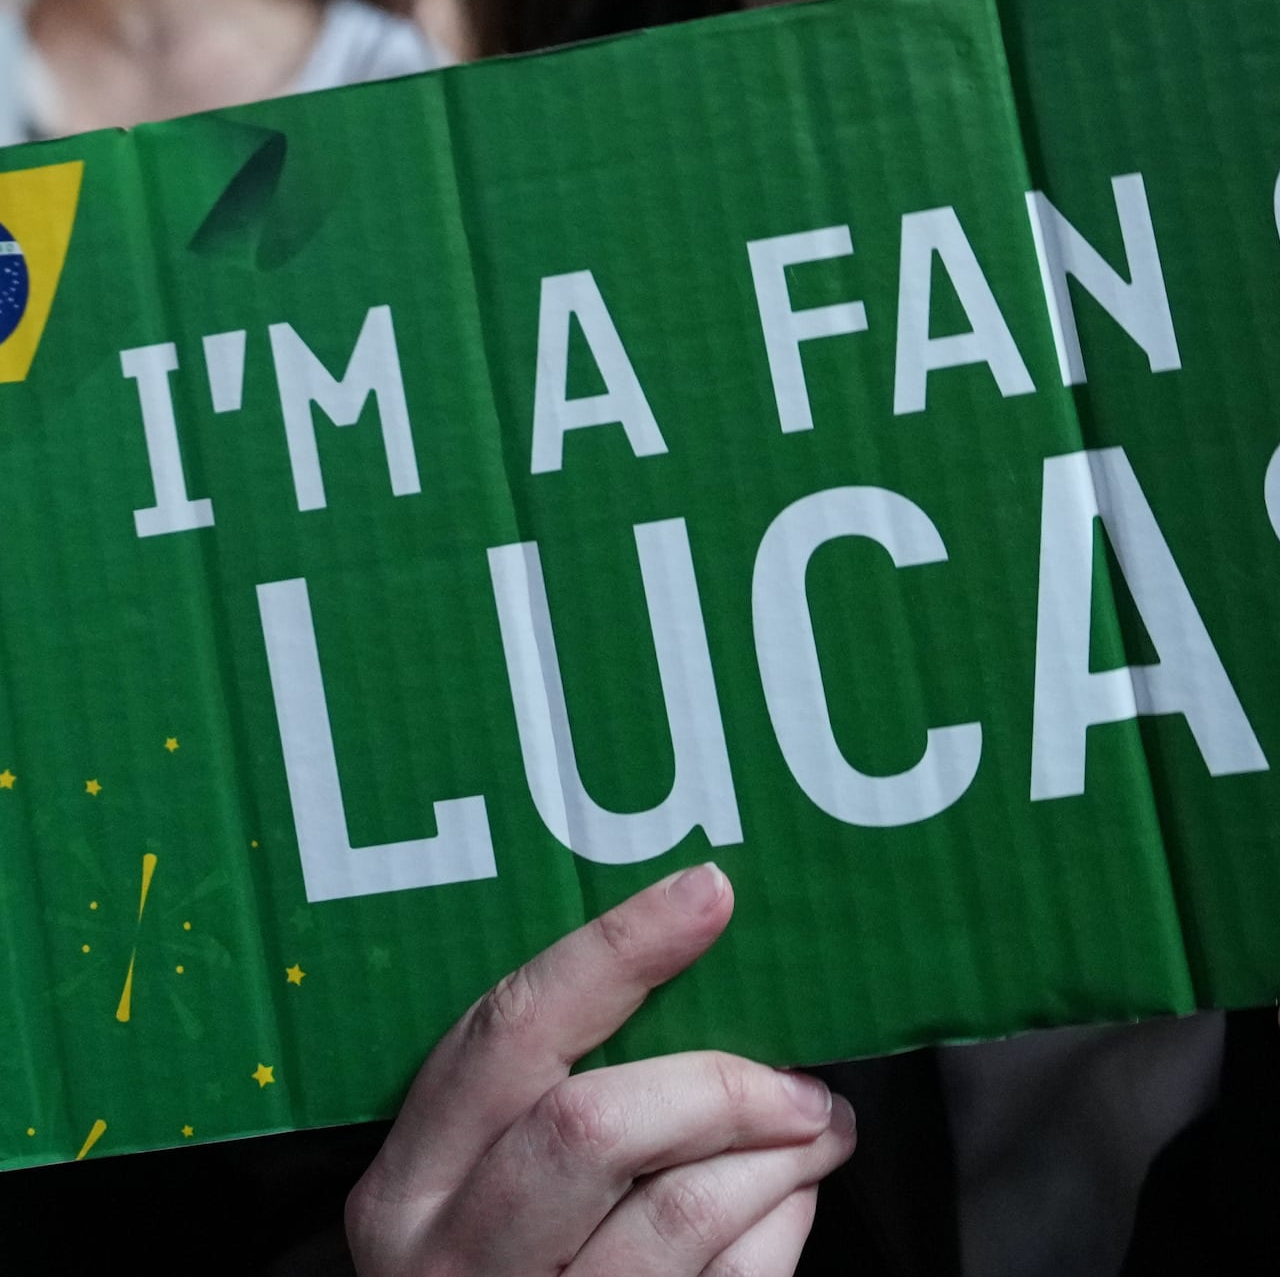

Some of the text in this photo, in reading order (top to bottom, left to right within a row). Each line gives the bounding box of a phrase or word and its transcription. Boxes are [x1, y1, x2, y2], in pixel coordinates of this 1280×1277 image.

[121, 305, 421, 538] I'M
[531, 271, 668, 474] A
[747, 173, 1181, 433] FAN
